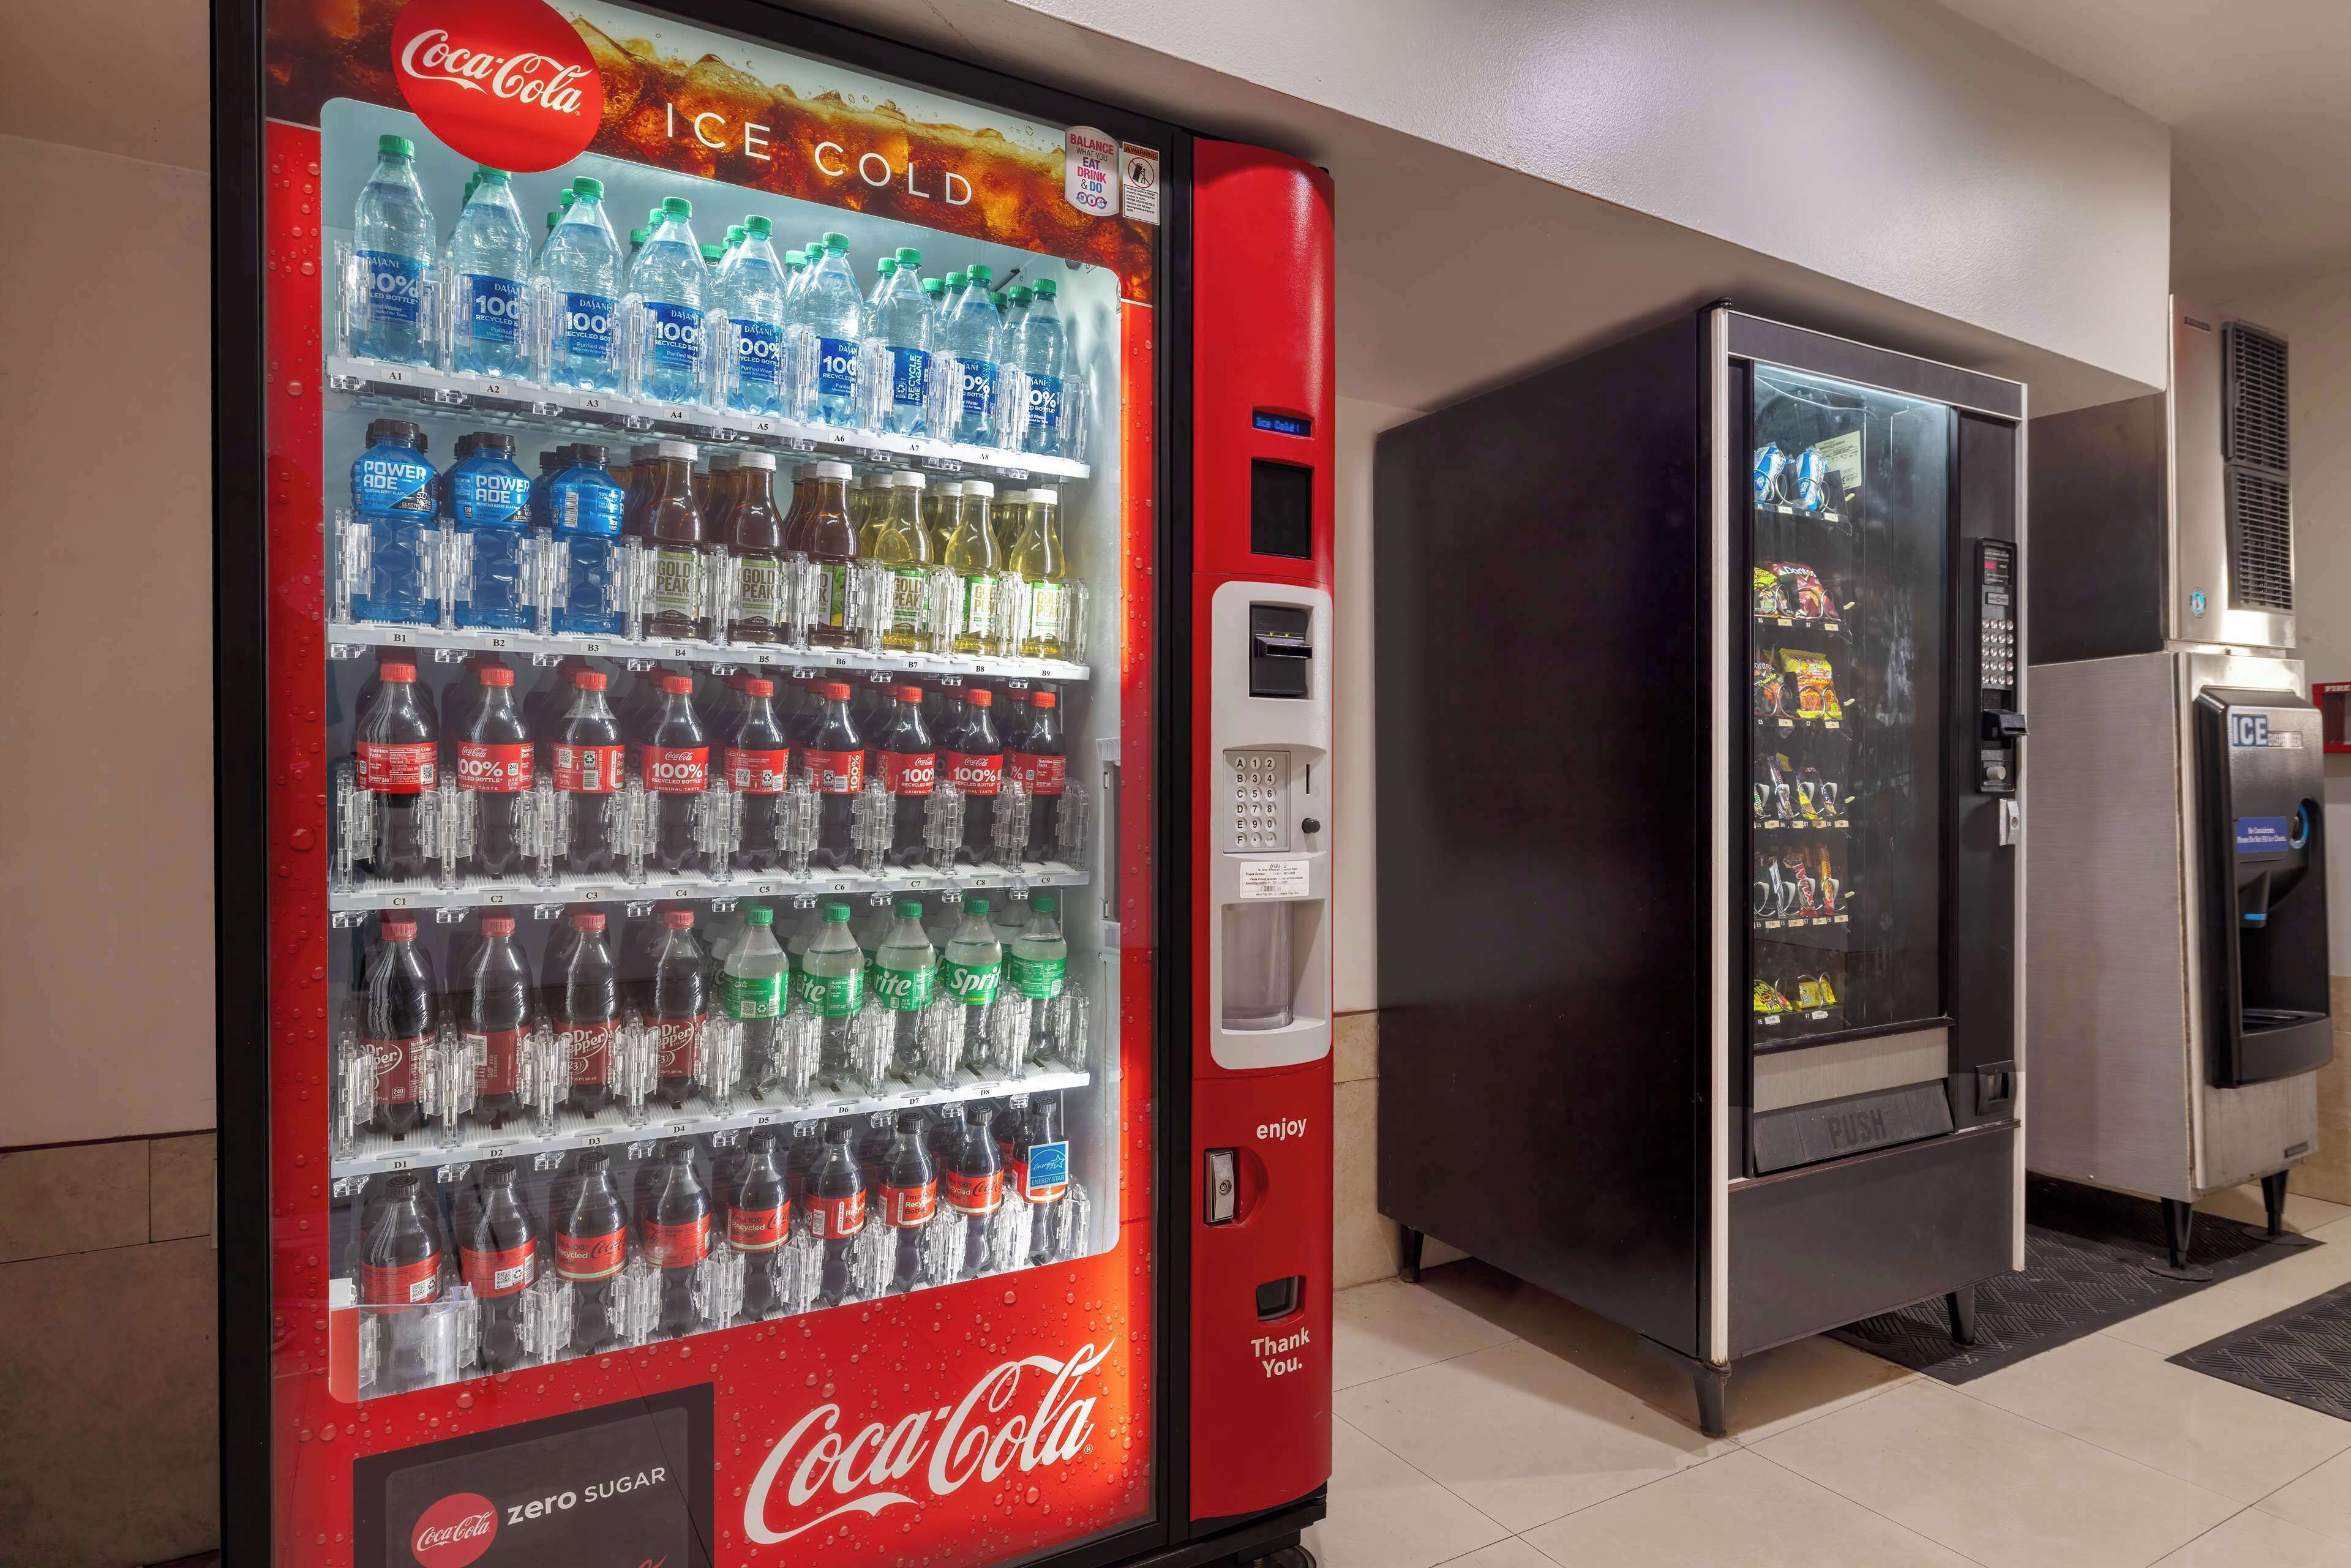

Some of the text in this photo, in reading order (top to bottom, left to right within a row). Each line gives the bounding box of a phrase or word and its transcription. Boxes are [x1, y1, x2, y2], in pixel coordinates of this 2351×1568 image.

[402, 29, 593, 116] Coca-Cola
[1070, 133, 1114, 156] BALANCE
[667, 103, 972, 206] ICE COLD
[1076, 147, 1108, 162] WHAT YOU
[1131, 148, 1157, 159] WARNING
[1077, 167, 1106, 184] DRINK
[1081, 179, 1103, 193] & DO
[384, 304, 402, 313] Water
[476, 314, 512, 324] RECYCLED
[491, 326, 512, 336] Purified
[744, 325, 772, 336] DASANI
[577, 342, 596, 351] Purified
[667, 351, 686, 359] Purified
[907, 354, 917, 400] RECYCLE
[914, 388, 921, 401] ME
[1256, 417, 1294, 432] Ice Cold
[364, 460, 427, 481] POWER
[364, 474, 398, 489] ADE
[476, 475, 529, 492] POWER
[476, 489, 511, 504] ADE
[658, 560, 691, 579] GOLD
[743, 568, 774, 584] GOLD
[1783, 566, 1817, 577] Doritos
[656, 576, 690, 593] PEAK
[743, 583, 774, 599] PEAK
[894, 591, 920, 608] PEAK
[394, 634, 407, 642] B1
[492, 639, 505, 647] B2
[587, 643, 599, 652] B3
[2232, 715, 2268, 746] ICE
[462, 746, 489, 758] Coca-Cola
[665, 751, 694, 761] Coca-Cola
[964, 757, 989, 767] Coca-Cola
[652, 762, 703, 779] 100%
[850, 754, 861, 791] 100%
[953, 767, 996, 782] 100%
[393, 897, 406, 906] C1
[573, 1029, 593, 1042] Dr
[662, 1024, 680, 1037] Dr
[366, 1044, 383, 1056] Dr
[1256, 1117, 1307, 1141] enjoy
[1827, 1108, 1887, 1150] PUSH
[490, 1149, 503, 1157] D2
[1032, 1174, 1065, 1186] ENERGY STAR
[732, 1221, 765, 1231] Recycled
[558, 1247, 588, 1259] Recycled
[1251, 1327, 1310, 1357] Thank
[1262, 1356, 1303, 1378] You.
[743, 1337, 1117, 1544] Coca-Cola
[508, 1467, 666, 1525] zero SUGAR
[416, 1507, 495, 1551] Coca-Cola
